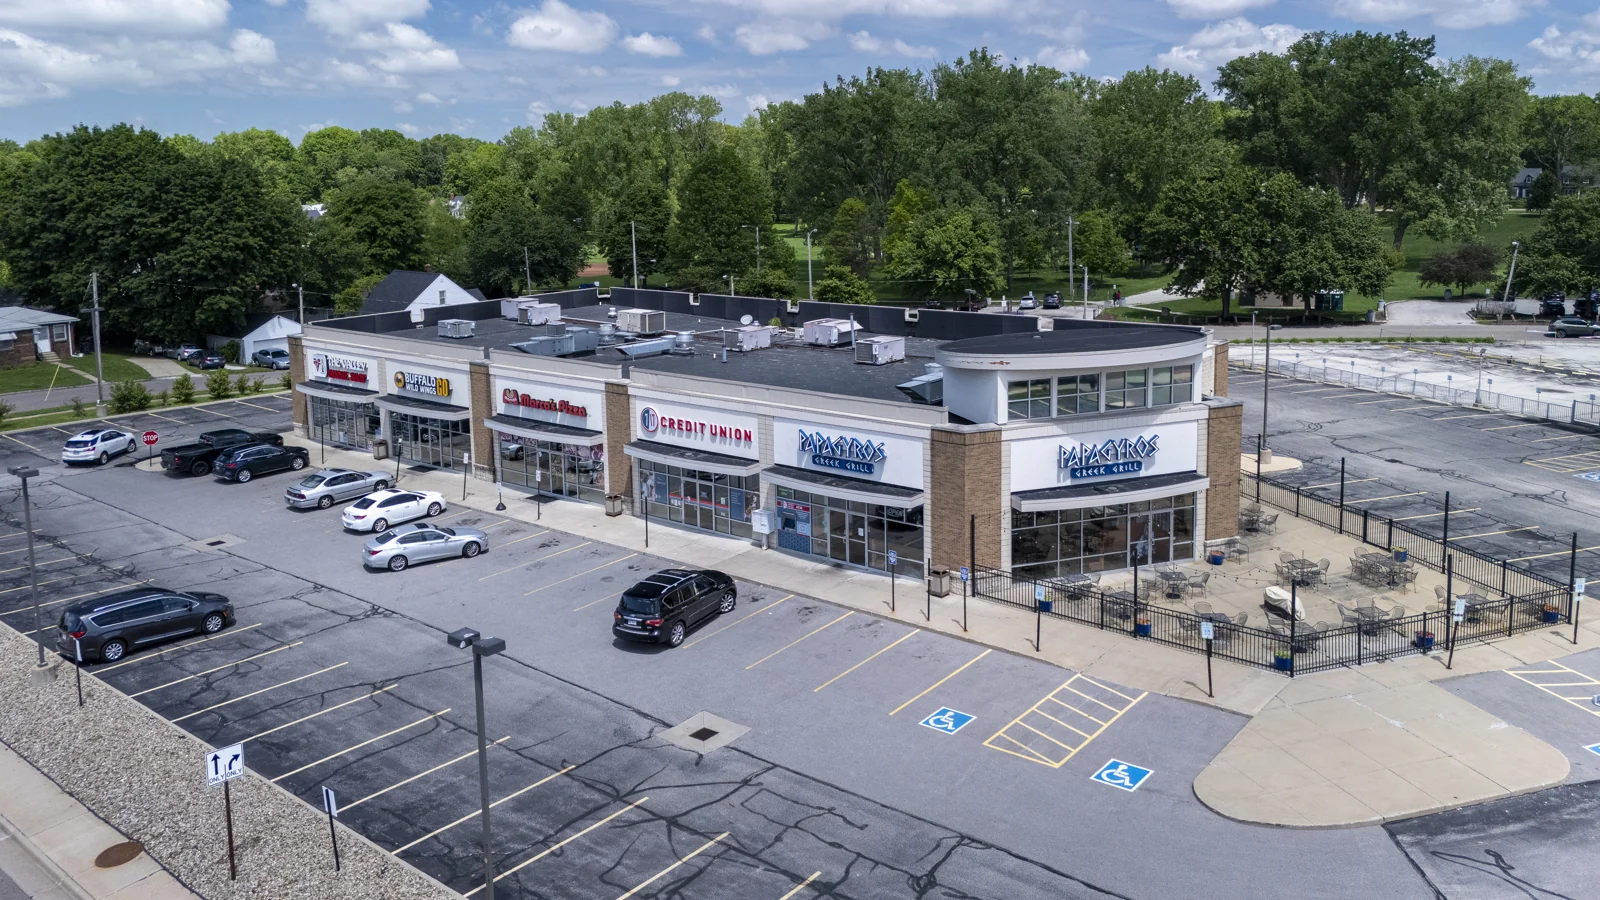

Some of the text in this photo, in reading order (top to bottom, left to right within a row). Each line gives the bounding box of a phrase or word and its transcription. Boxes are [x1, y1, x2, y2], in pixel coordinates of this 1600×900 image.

[329, 357, 341, 368] THE
[342, 359, 368, 371] VALLEY
[405, 372, 436, 387] BUFFALO
[436, 378, 449, 397] GO
[406, 383, 437, 395] WILD WINGS
[520, 394, 587, 417] Marco's Pizza
[660, 416, 706, 434] CREDIT
[710, 424, 752, 442] UNION
[143, 434, 158, 442] STOP
[799, 429, 886, 463] PAPAGYROS
[1059, 435, 1160, 468] PAPAGYROS
[814, 456, 870, 473] GREEK GRILL
[1075, 462, 1139, 478] GREEK GRILL
[209, 774, 225, 784] ONLY
[226, 768, 243, 778] ONLY
